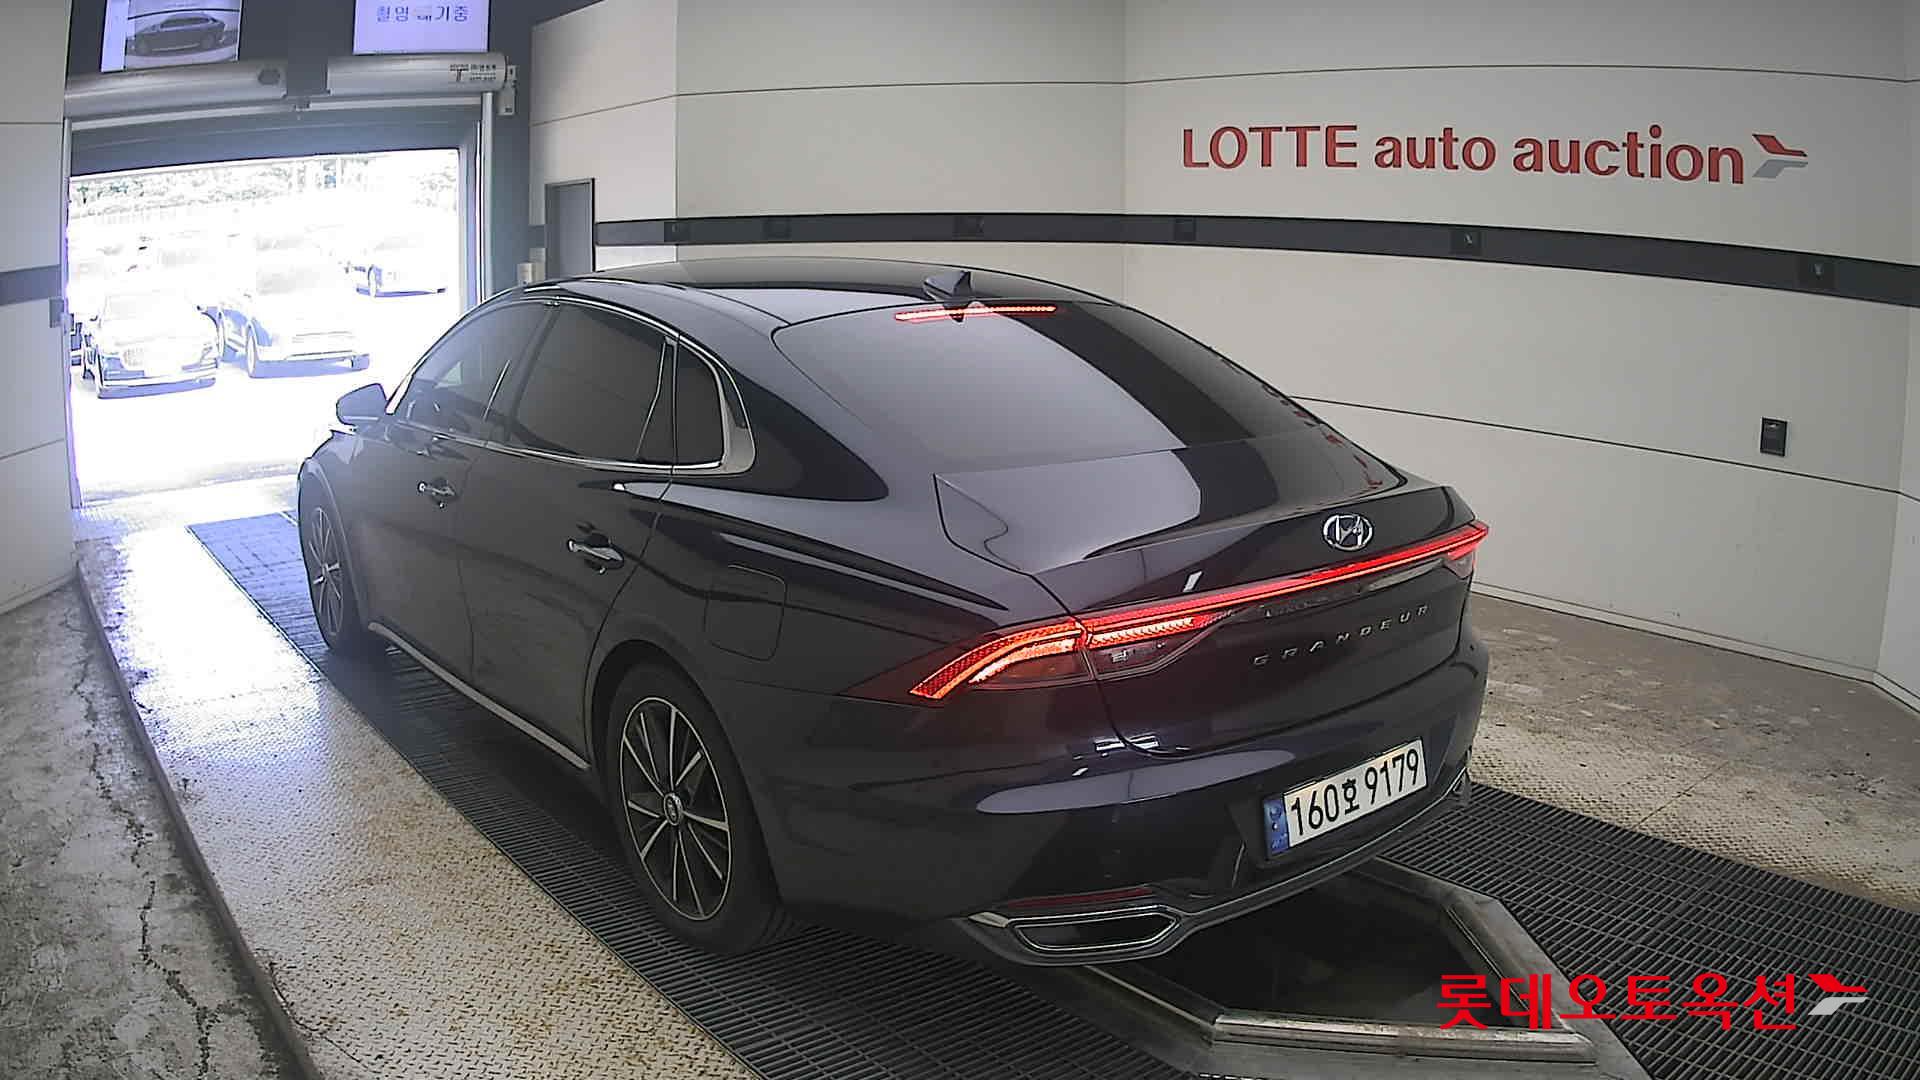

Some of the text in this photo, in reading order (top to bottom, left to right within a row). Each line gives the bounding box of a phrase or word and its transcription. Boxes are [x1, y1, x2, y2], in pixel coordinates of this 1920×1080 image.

[1183, 125, 1744, 184] LOTTE auto auction
[1253, 604, 1429, 666] GRANDEUR
[1291, 748, 1420, 836] 160호 9179
